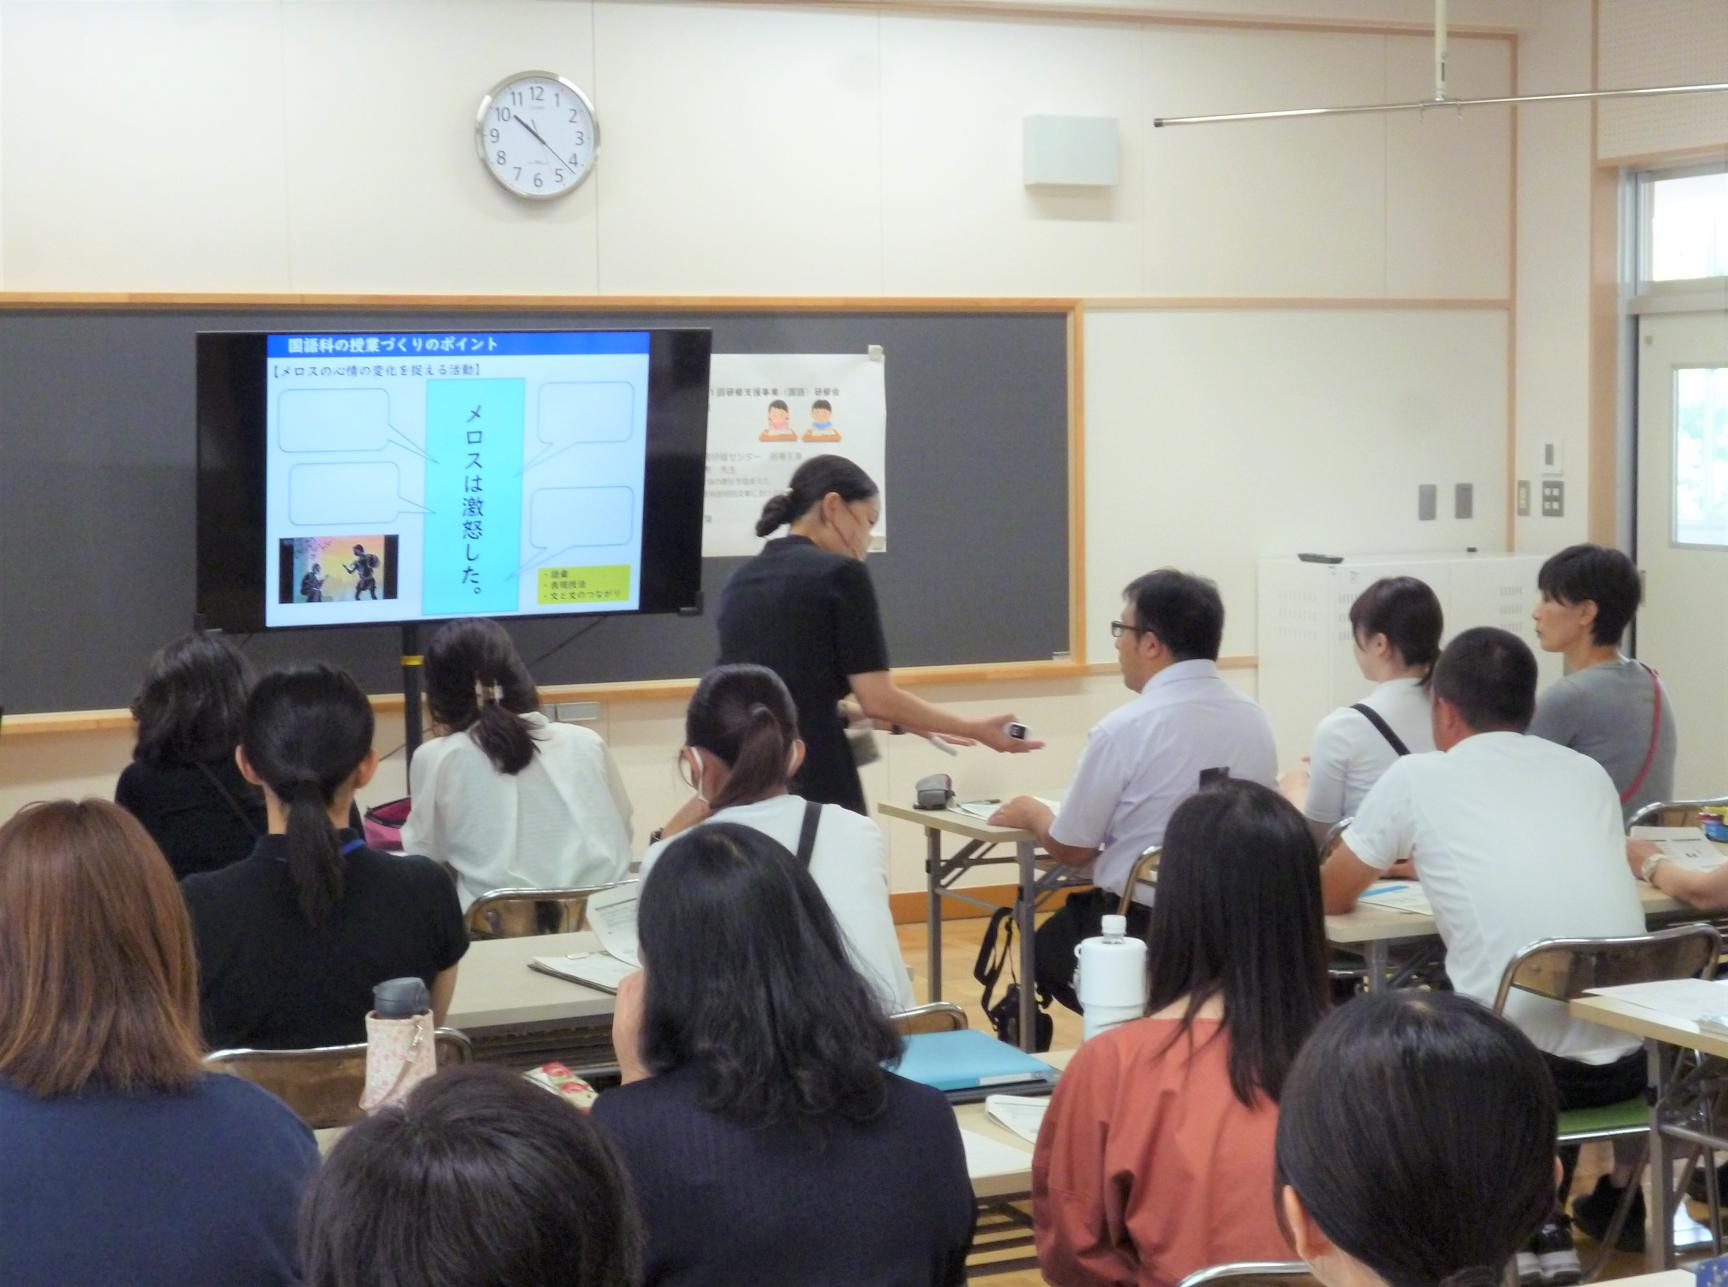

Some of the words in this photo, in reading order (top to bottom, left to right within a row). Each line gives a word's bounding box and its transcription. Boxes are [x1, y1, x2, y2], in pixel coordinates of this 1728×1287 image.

[510, 91, 523, 106] 11
[529, 86, 544, 101] 12
[554, 92, 560, 107] 1
[495, 107, 511, 122] 10
[568, 109, 577, 123] 2
[490, 128, 500, 143] 9
[575, 131, 585, 146] 3
[496, 150, 506, 165] 8
[568, 153, 578, 167] 4
[513, 166, 522, 181] 7
[533, 173, 543, 188] 6
[554, 168, 564, 183] 5
[287, 336, 499, 354] 国語科の授業づくりのポイント
[460, 403, 484, 595] メロスは激怒した。
